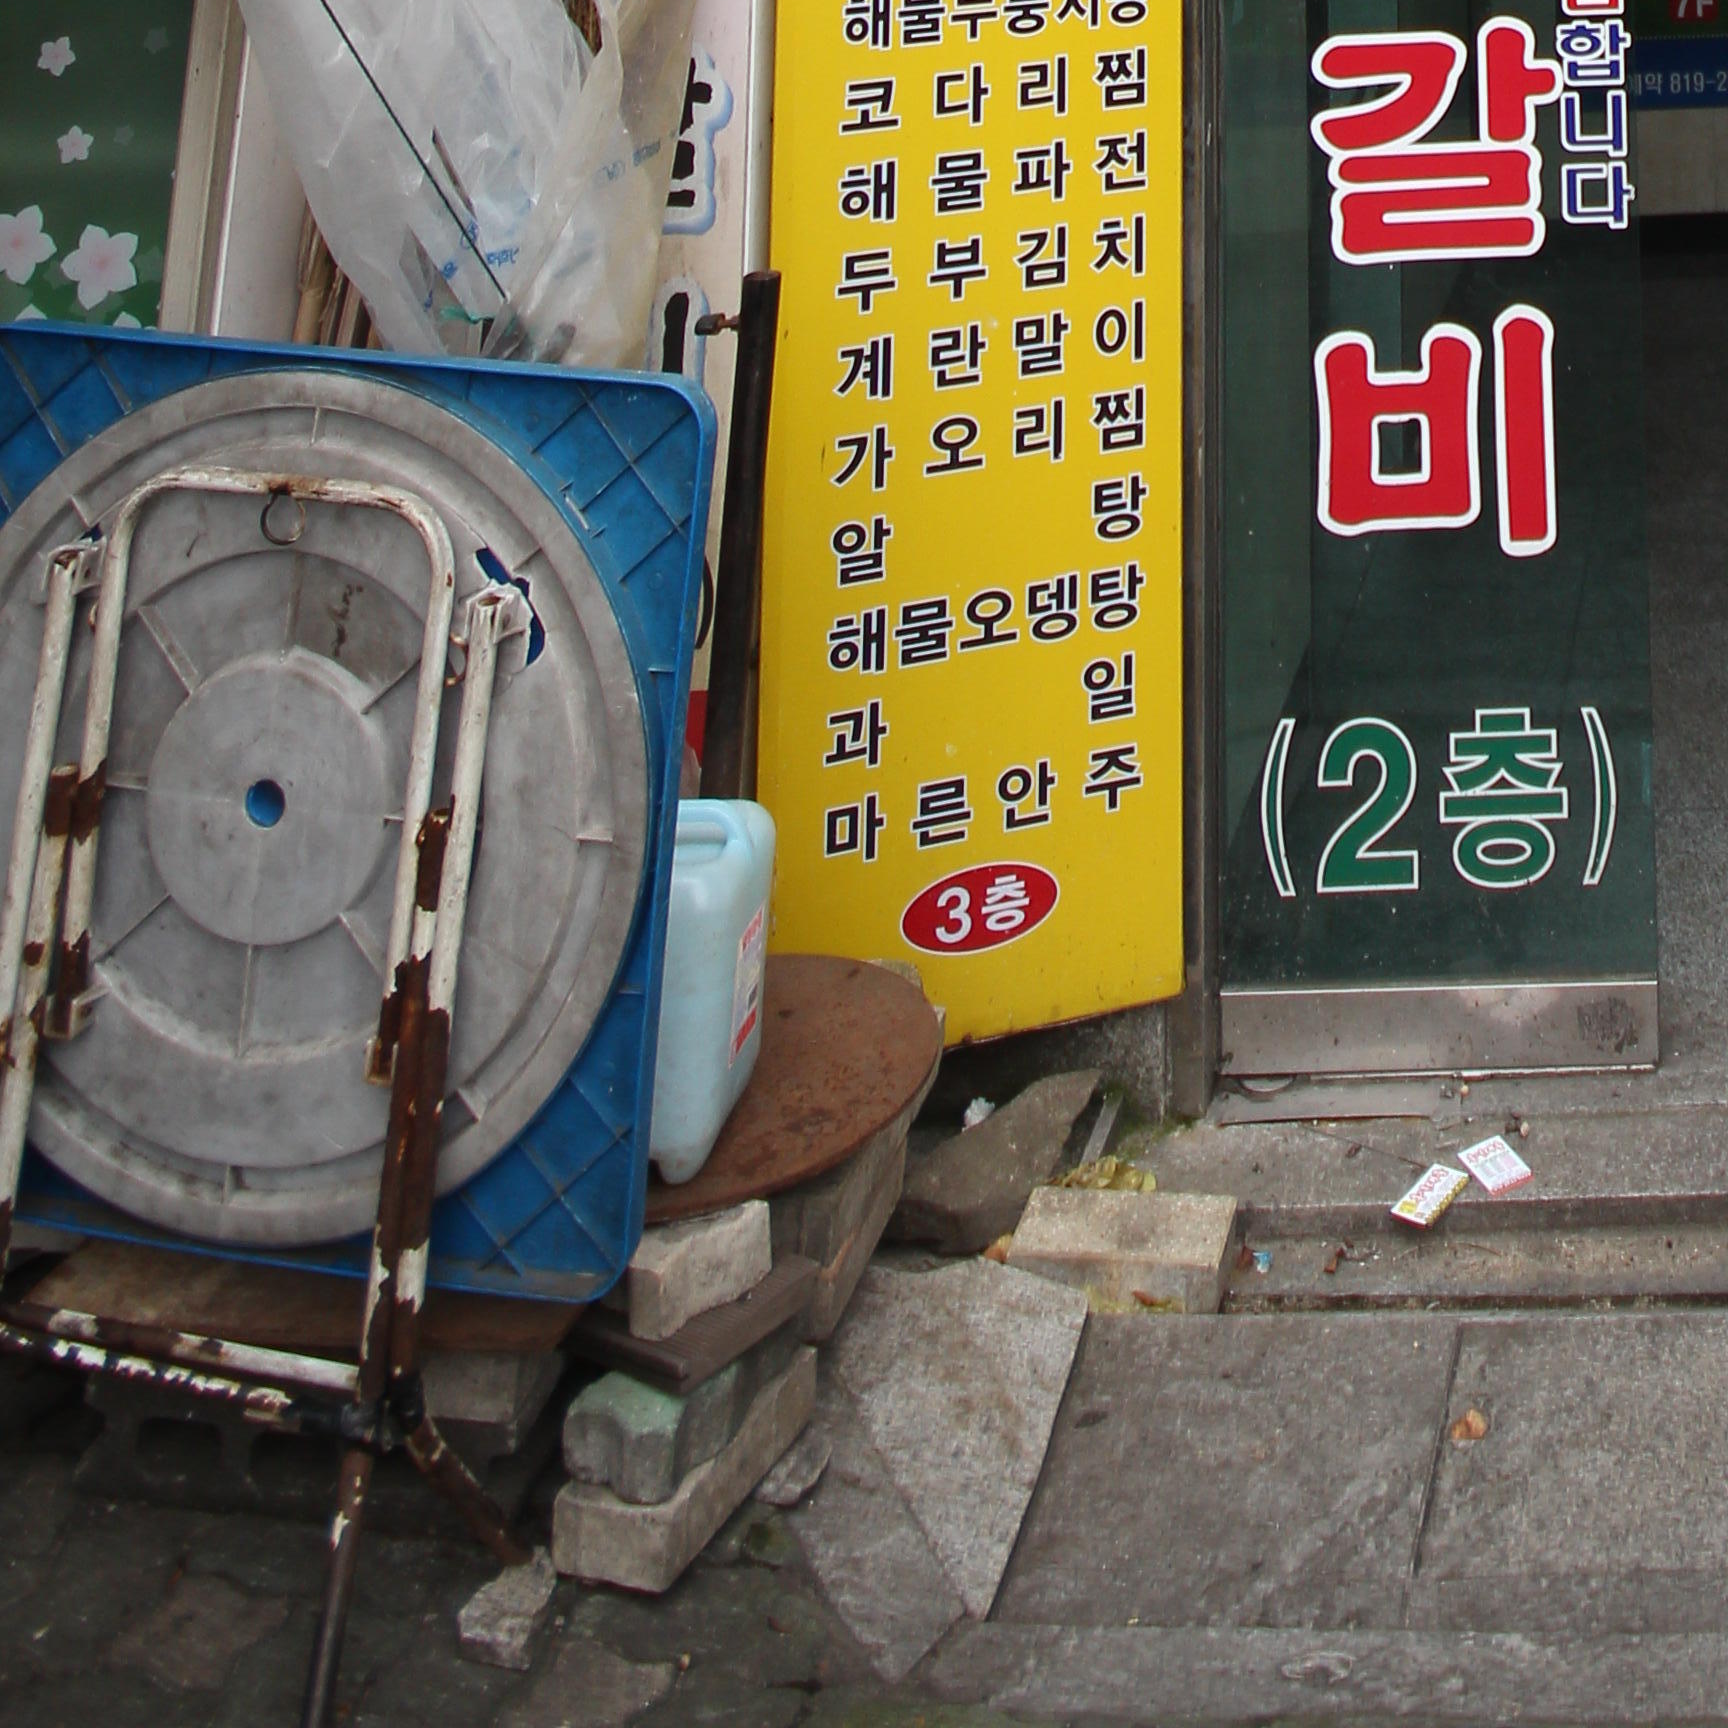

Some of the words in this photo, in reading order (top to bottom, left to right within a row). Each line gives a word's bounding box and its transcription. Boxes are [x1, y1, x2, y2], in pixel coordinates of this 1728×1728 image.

[839, 47, 1148, 134] 코다리찜
[838, 130, 1148, 222] 해물파전
[836, 214, 1146, 314] 두부김치
[834, 300, 1146, 400] 계란말이
[831, 385, 1146, 490] 가오리찜
[827, 562, 1145, 674] 해물오뎅탕
[824, 742, 1143, 863] 마른안주
[1260, 706, 1617, 897] (2층)
[935, 872, 1031, 945] 3층
